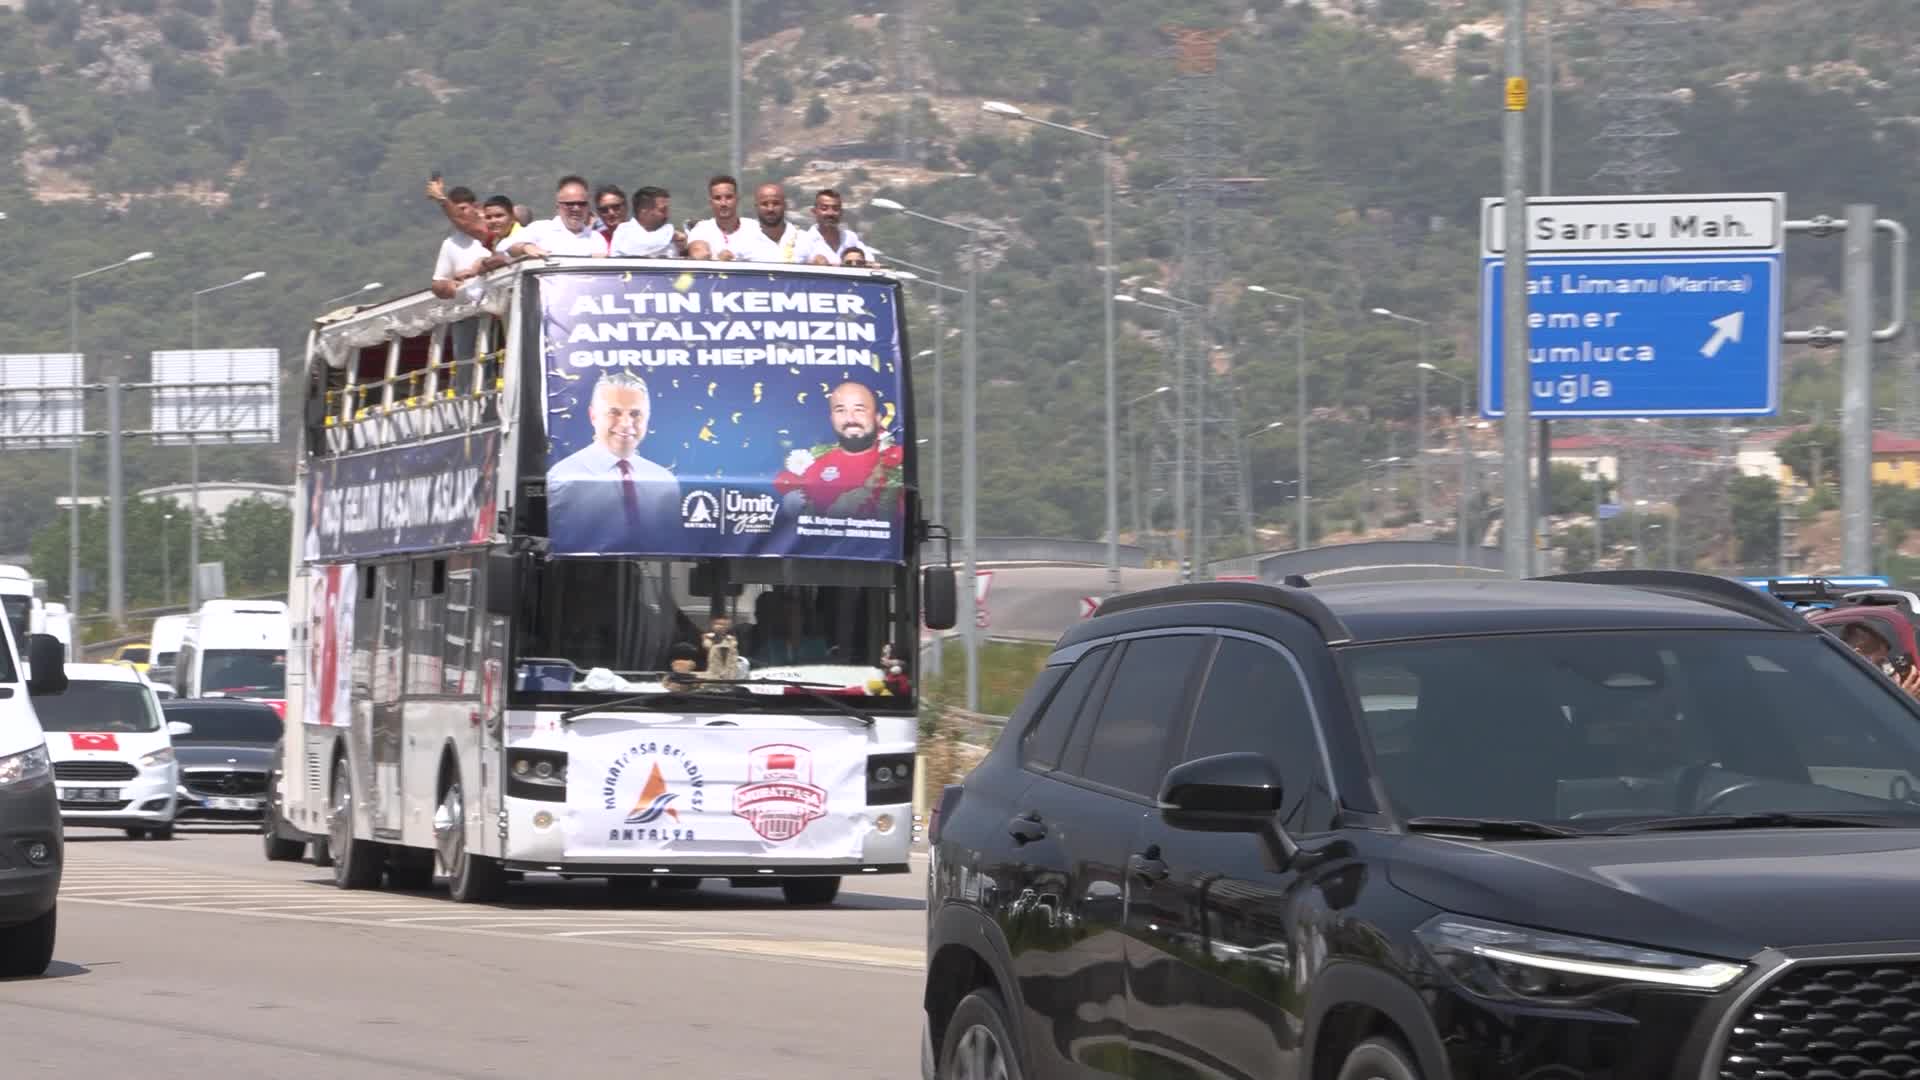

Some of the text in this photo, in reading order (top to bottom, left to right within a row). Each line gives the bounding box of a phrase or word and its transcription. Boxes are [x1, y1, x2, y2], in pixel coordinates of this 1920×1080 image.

[1535, 214, 1753, 241] Sarısu Mah.
[1525, 273, 1753, 295] at Limanı (Marina)
[568, 291, 868, 316] ALTIN KEMER
[568, 320, 876, 343] ANTALYA'MIZIN
[1527, 311, 1622, 329] emer
[569, 343, 873, 368] GURUR HEPİMİZİN
[1528, 341, 1656, 364] umluca
[1532, 374, 1613, 404] uğla
[726, 489, 775, 512] Ümit
[608, 828, 695, 841] ANTALYA
